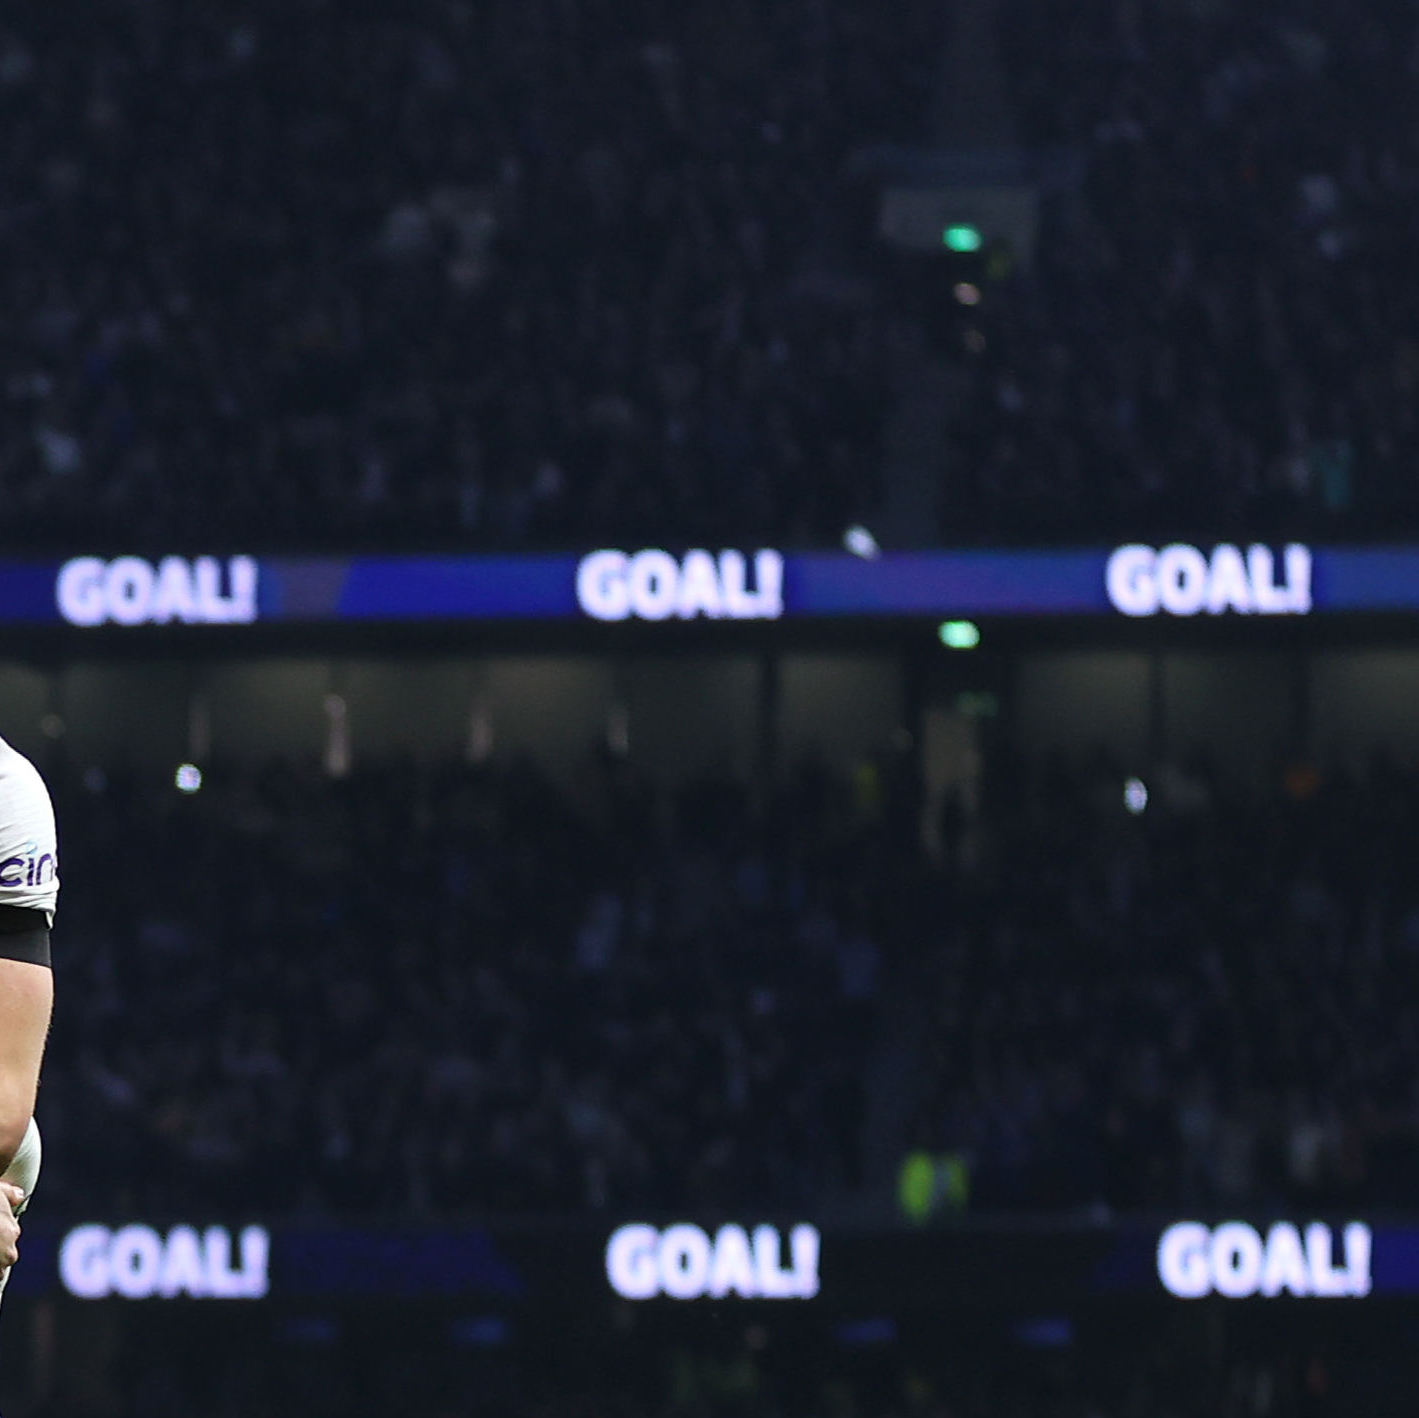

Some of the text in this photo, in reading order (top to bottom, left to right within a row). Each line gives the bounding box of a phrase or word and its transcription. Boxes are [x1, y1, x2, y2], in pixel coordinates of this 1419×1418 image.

[56, 555, 258, 627] GOAL!
[576, 549, 784, 621] GOAL!
[1105, 543, 1312, 617] GOAL!
[60, 1225, 269, 1299] GOAL!
[605, 1223, 820, 1300] GOAL!
[1157, 1221, 1372, 1299] GOAL!
